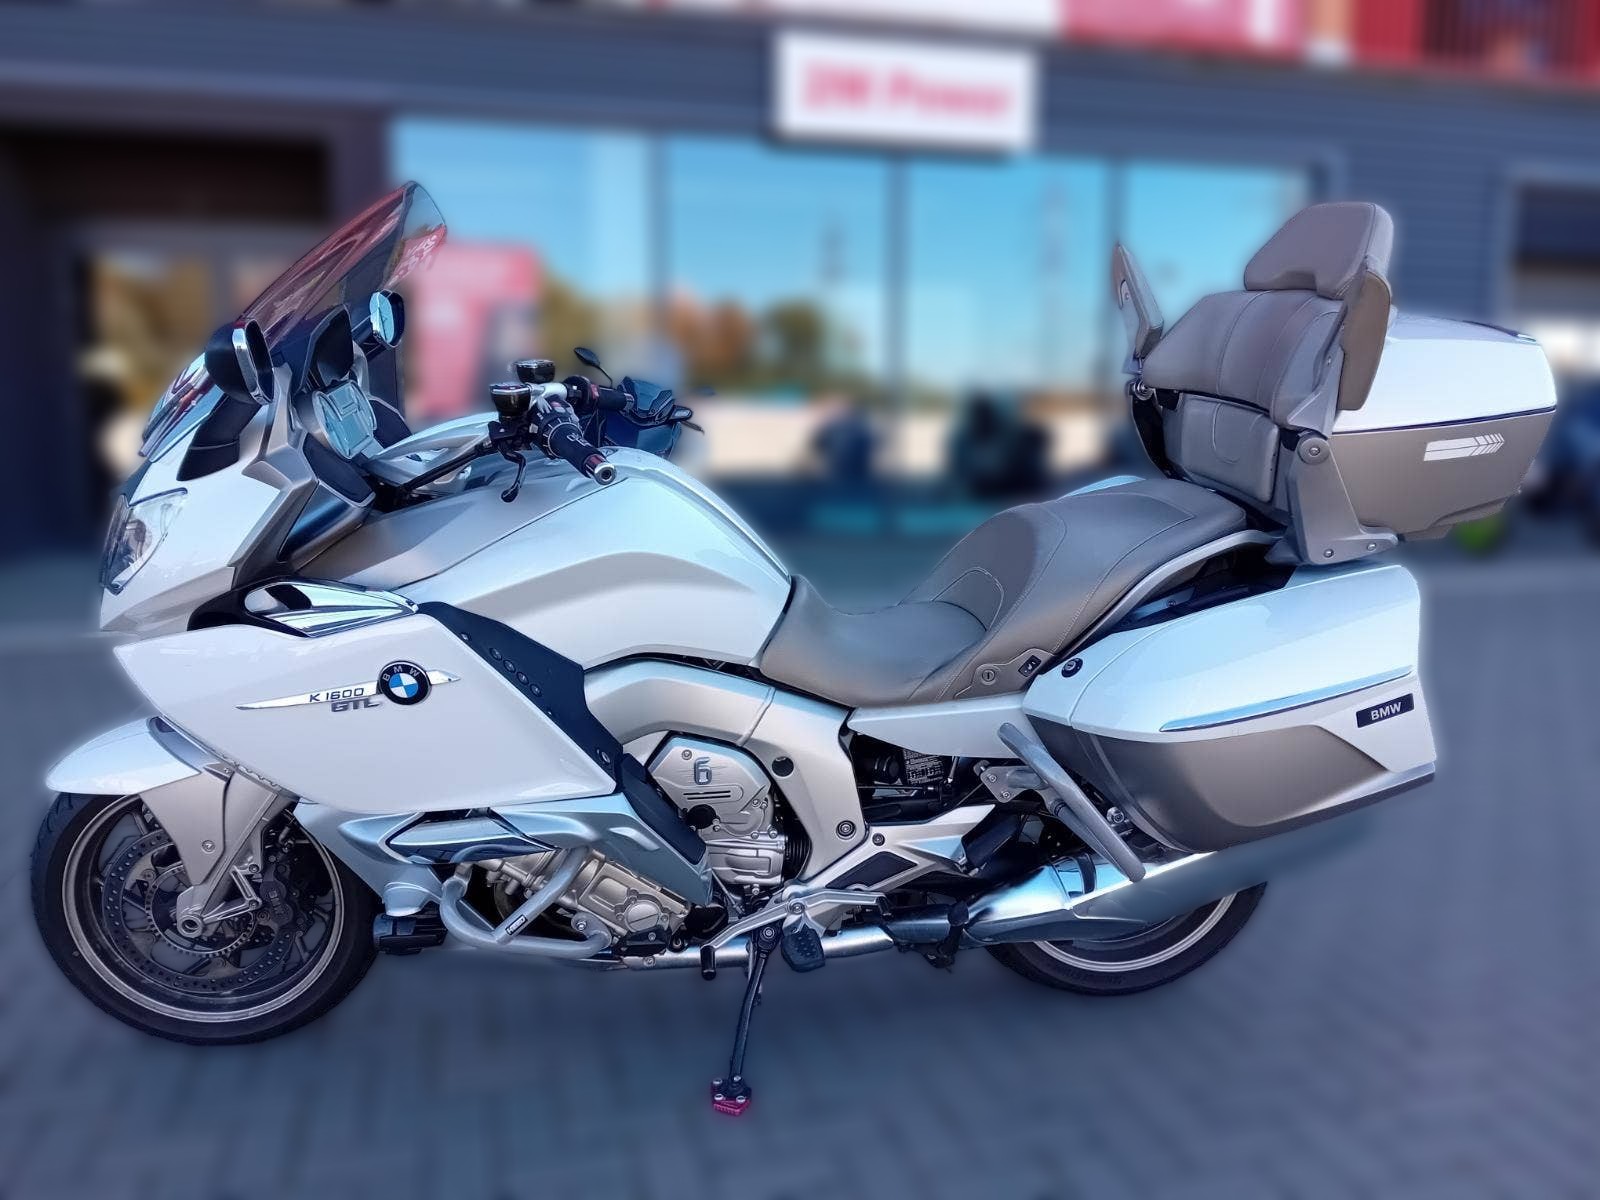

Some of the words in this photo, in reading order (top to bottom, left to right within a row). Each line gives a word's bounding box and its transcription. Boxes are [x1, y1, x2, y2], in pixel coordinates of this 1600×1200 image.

[382, 665, 420, 682] BMW
[309, 694, 321, 703] K
[326, 687, 365, 701] 1600
[331, 697, 380, 713] GTL
[1370, 701, 1402, 721] BMW
[694, 756, 712, 785] 6
